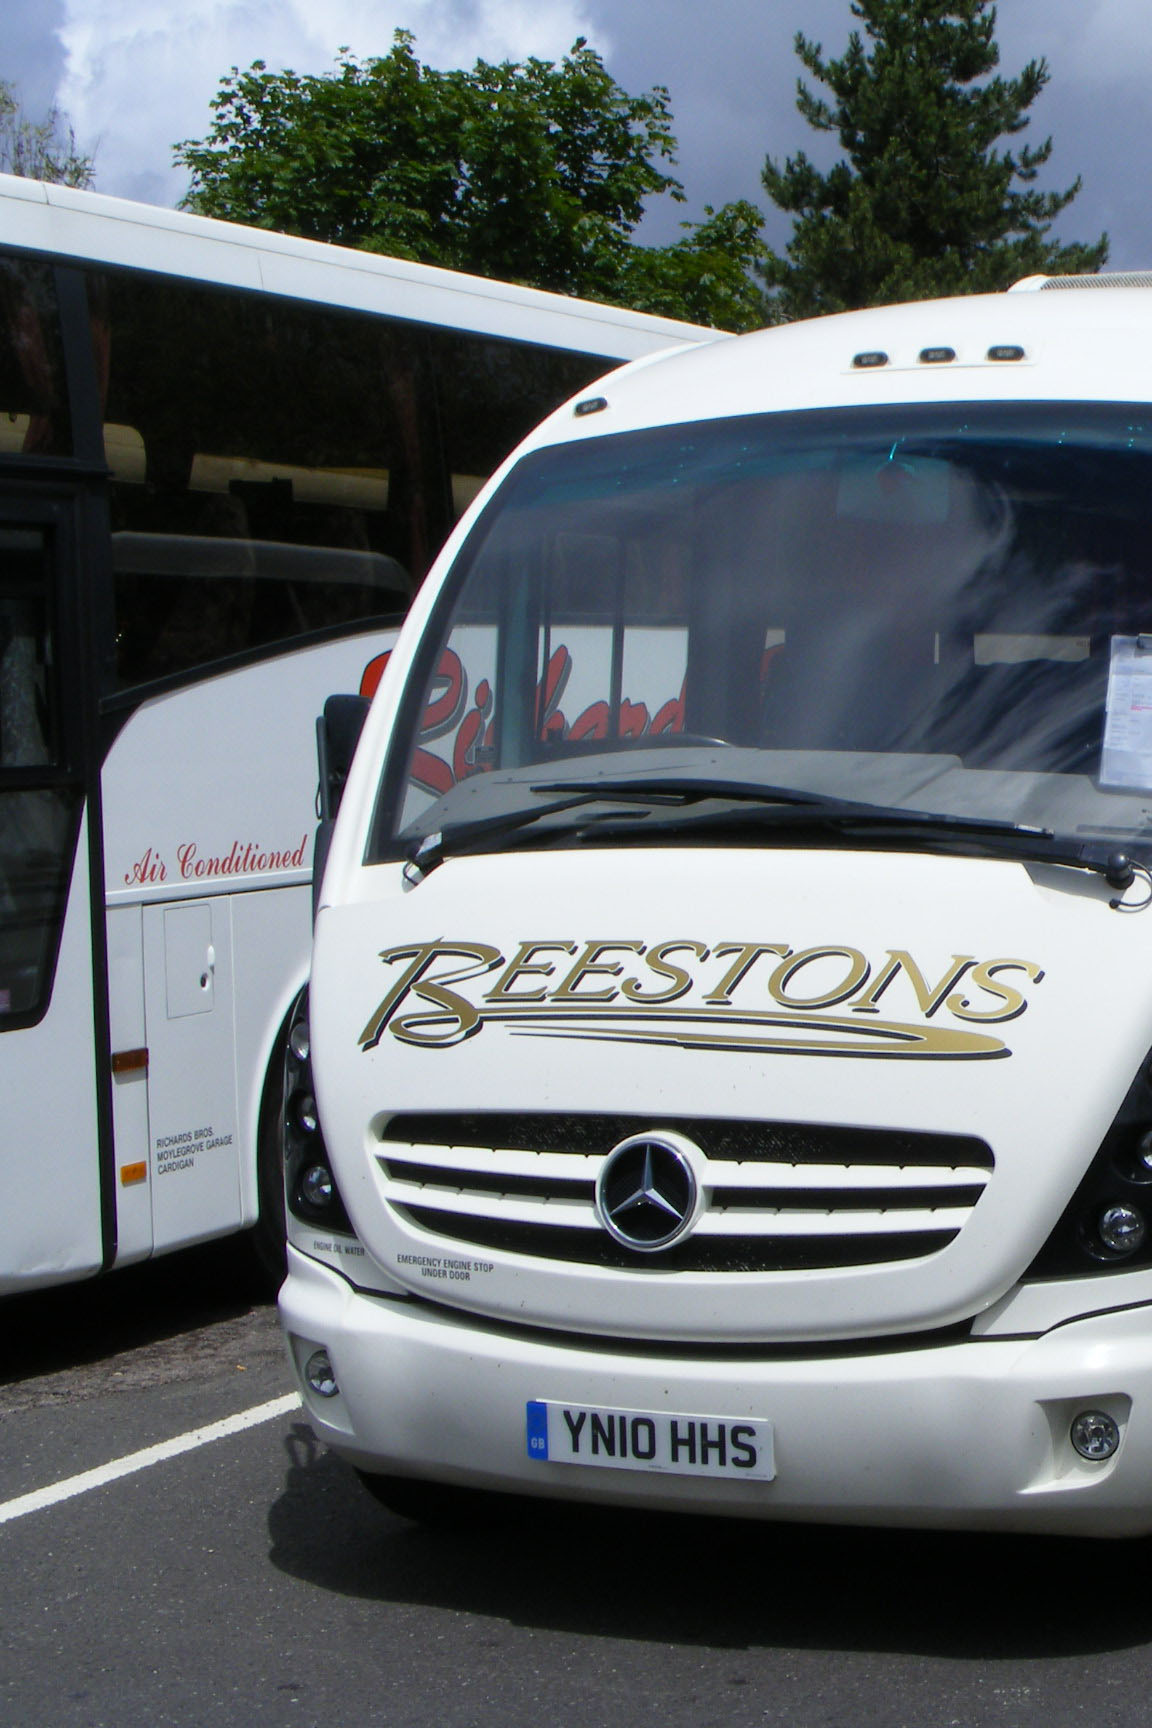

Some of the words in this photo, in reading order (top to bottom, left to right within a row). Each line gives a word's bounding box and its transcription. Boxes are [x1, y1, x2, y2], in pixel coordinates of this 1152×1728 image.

[124, 847, 168, 886] Air
[177, 834, 307, 879] Conditioned
[357, 936, 1044, 1058] BEESTONS
[156, 1131, 193, 1149] RICHARDS
[205, 1134, 233, 1150] GARAGE
[158, 1158, 194, 1174] CARDIGAN
[397, 1254, 441, 1267] EMERGENCY
[443, 1260, 472, 1271] ENGINE
[473, 1262, 494, 1273] STOP
[421, 1267, 448, 1279] UNDER
[449, 1270, 471, 1281] DOOR
[530, 1437, 545, 1450] GB
[562, 1410, 656, 1460] YN10
[670, 1420, 757, 1468] HHS
